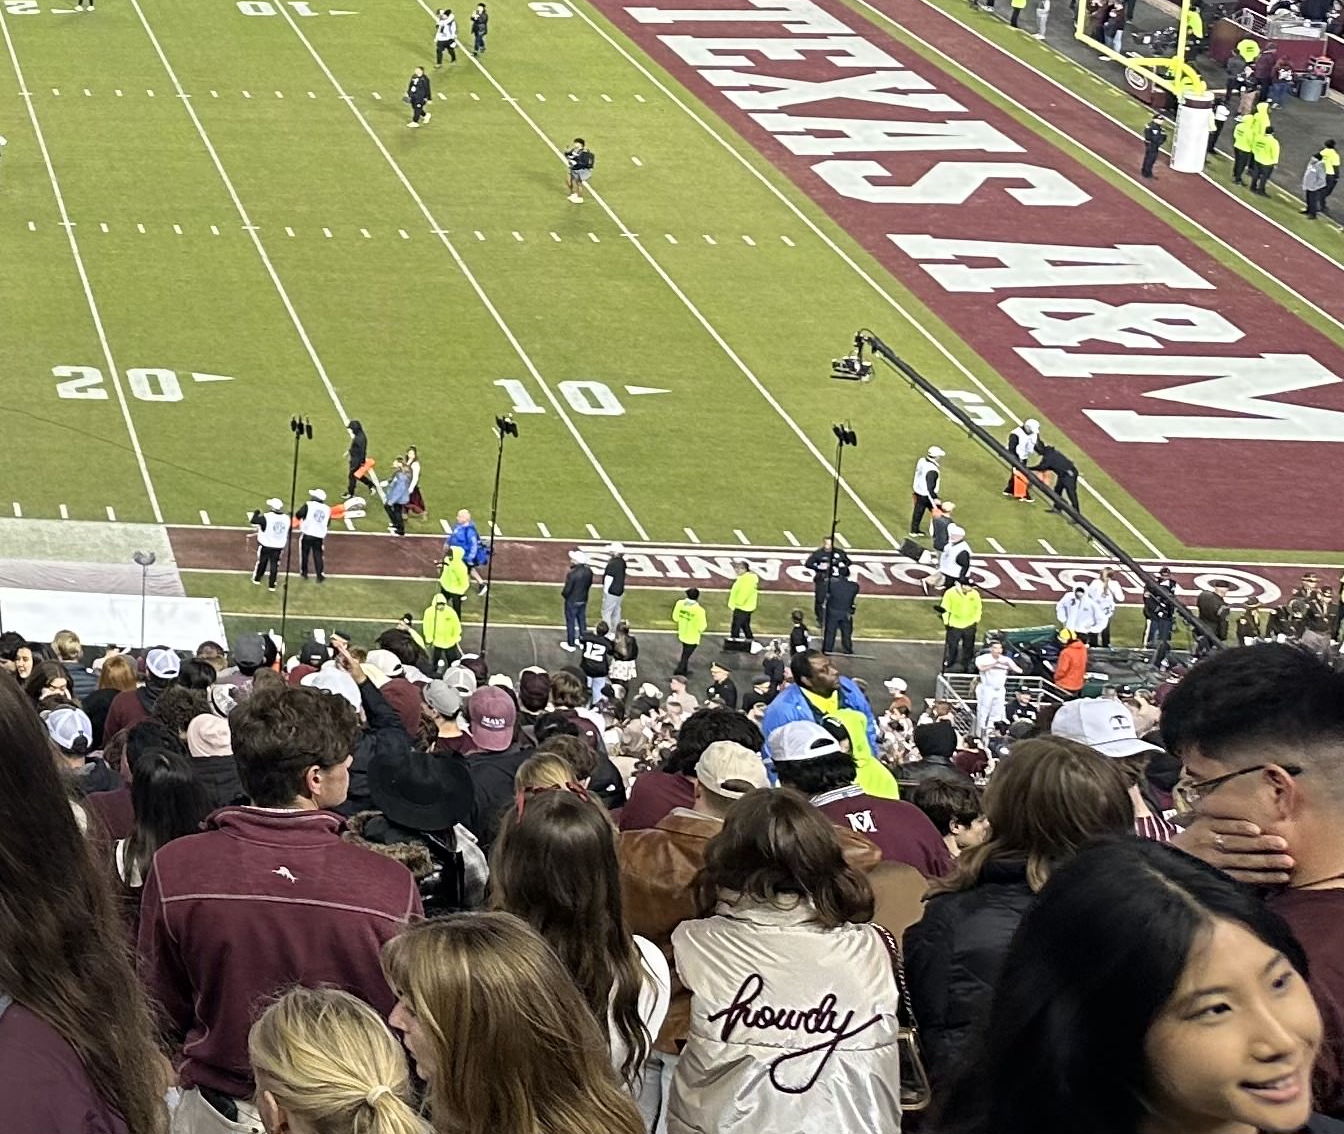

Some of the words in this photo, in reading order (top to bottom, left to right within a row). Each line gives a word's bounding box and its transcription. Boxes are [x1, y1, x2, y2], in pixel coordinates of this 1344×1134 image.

[235, 0, 320, 17] 10
[886, 232, 1344, 444] A&M
[51, 365, 184, 402] 20
[493, 378, 626, 416] 10
[583, 641, 607, 662] 12
[480, 715, 507, 726] MAYS
[707, 972, 884, 1095] howdy
